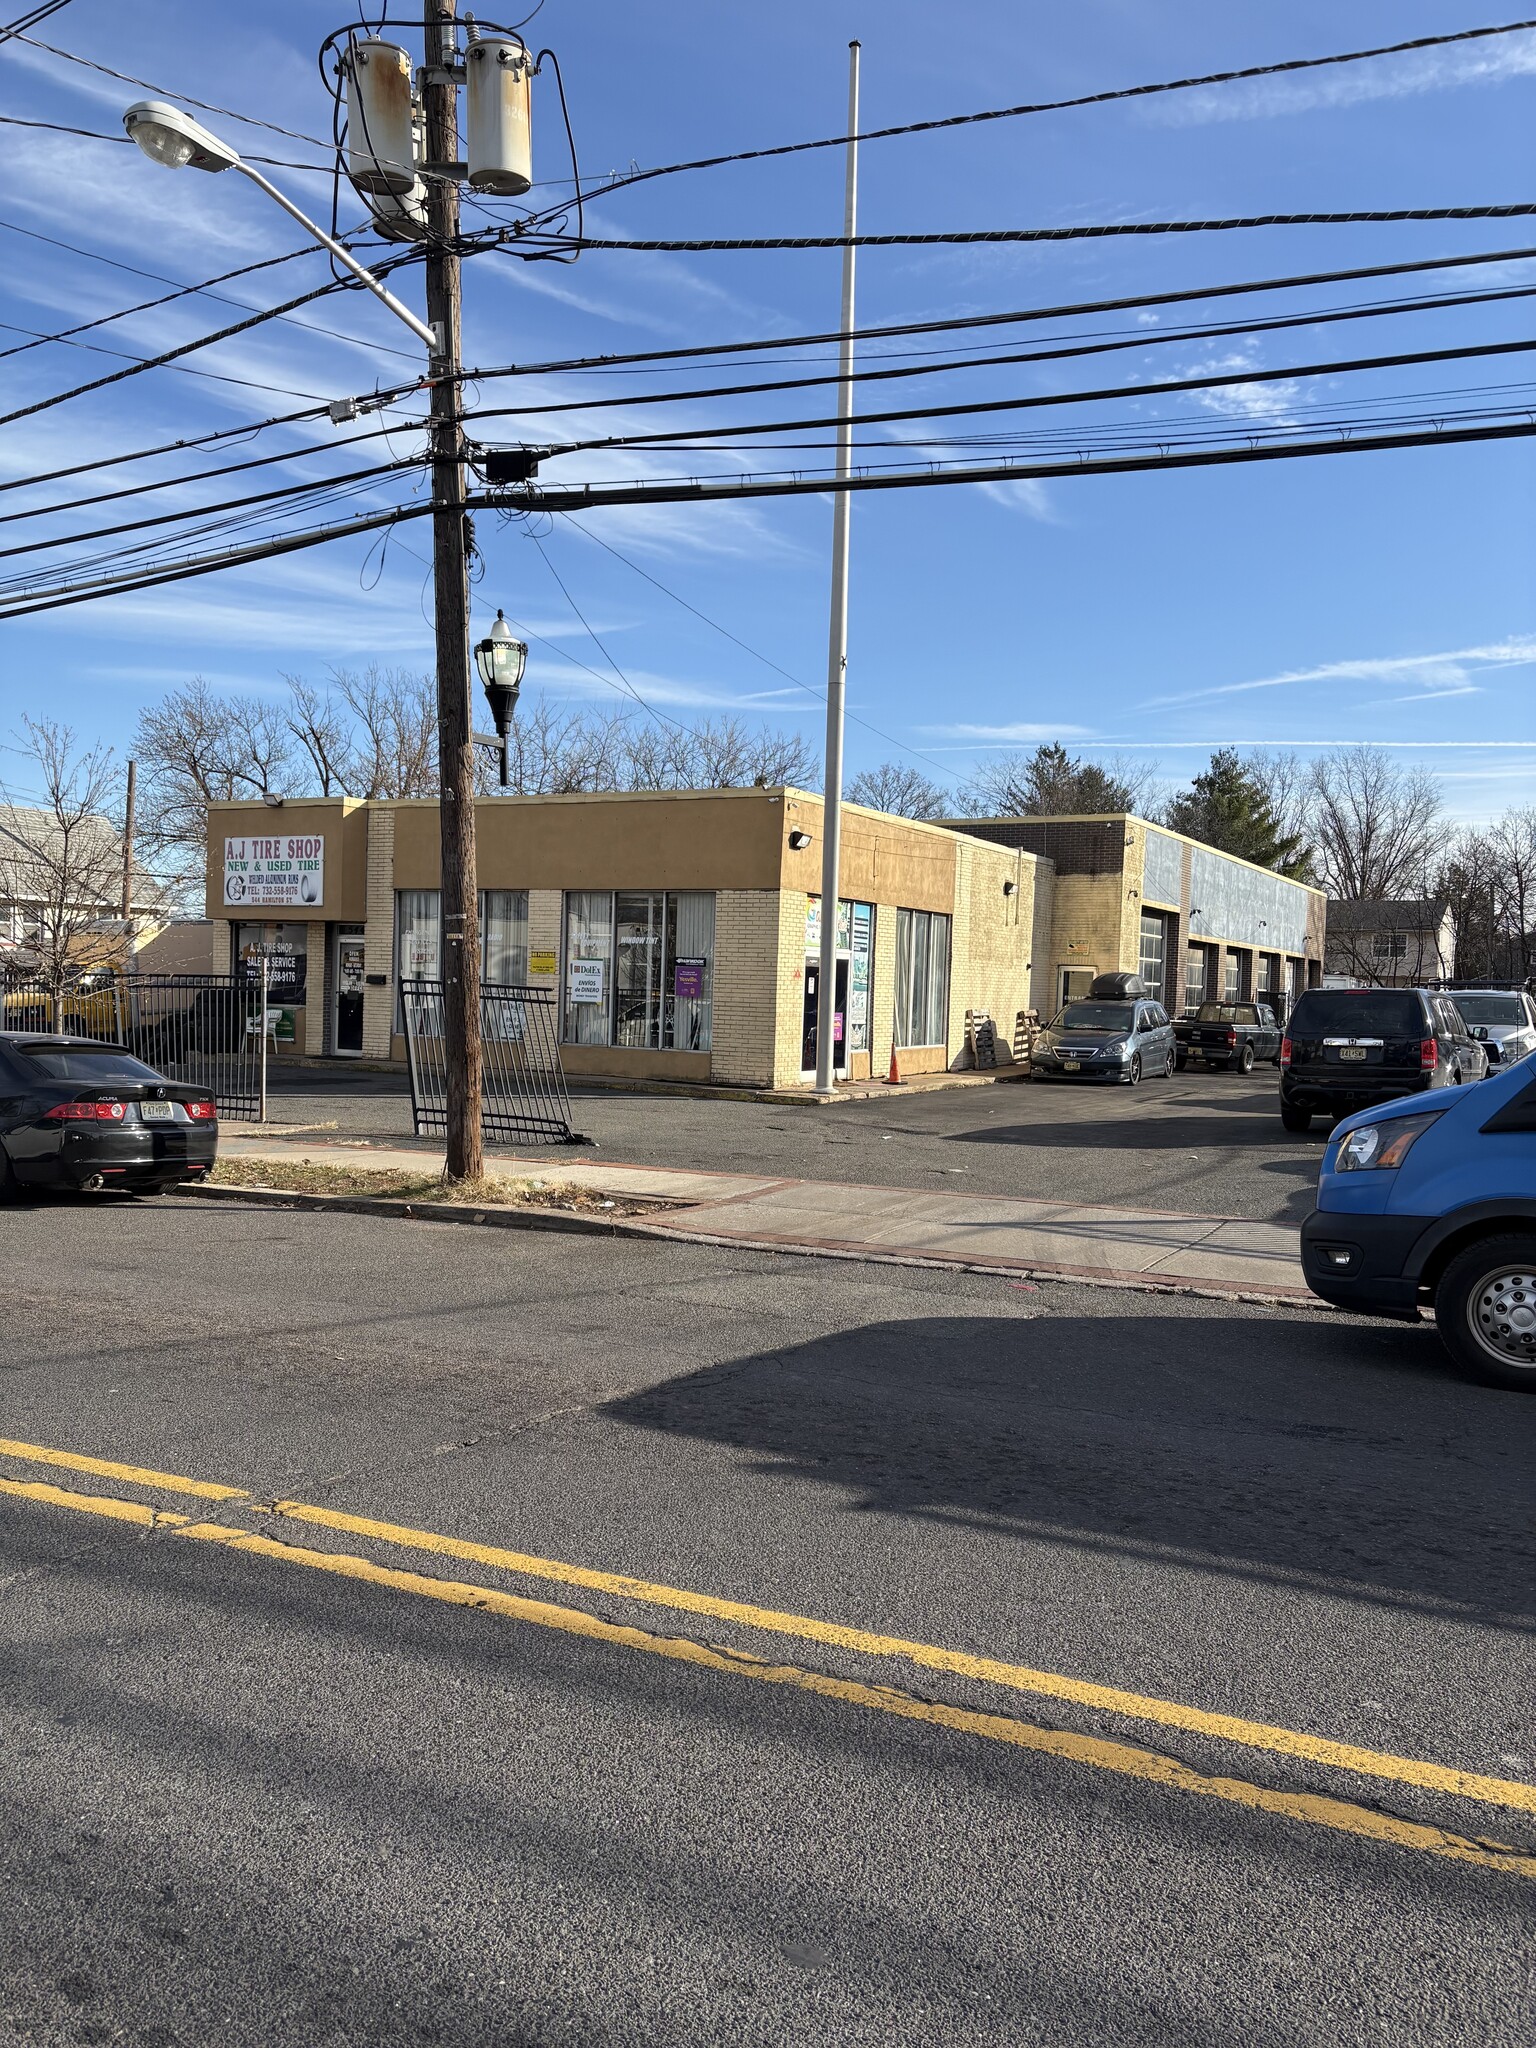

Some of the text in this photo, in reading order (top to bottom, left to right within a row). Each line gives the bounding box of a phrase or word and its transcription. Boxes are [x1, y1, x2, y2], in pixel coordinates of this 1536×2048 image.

[226, 839, 321, 860] A.J TIRE SHOP
[228, 860, 320, 871] NEW & USED TIRE
[247, 886, 298, 895] TEL: 732-558-9176
[621, 936, 646, 944] WINDOW
[263, 942, 276, 952] TIRE
[277, 943, 293, 953] SHOP
[247, 957, 264, 966] SALE
[271, 957, 296, 967] SERVICE
[581, 965, 601, 974] DolEx
